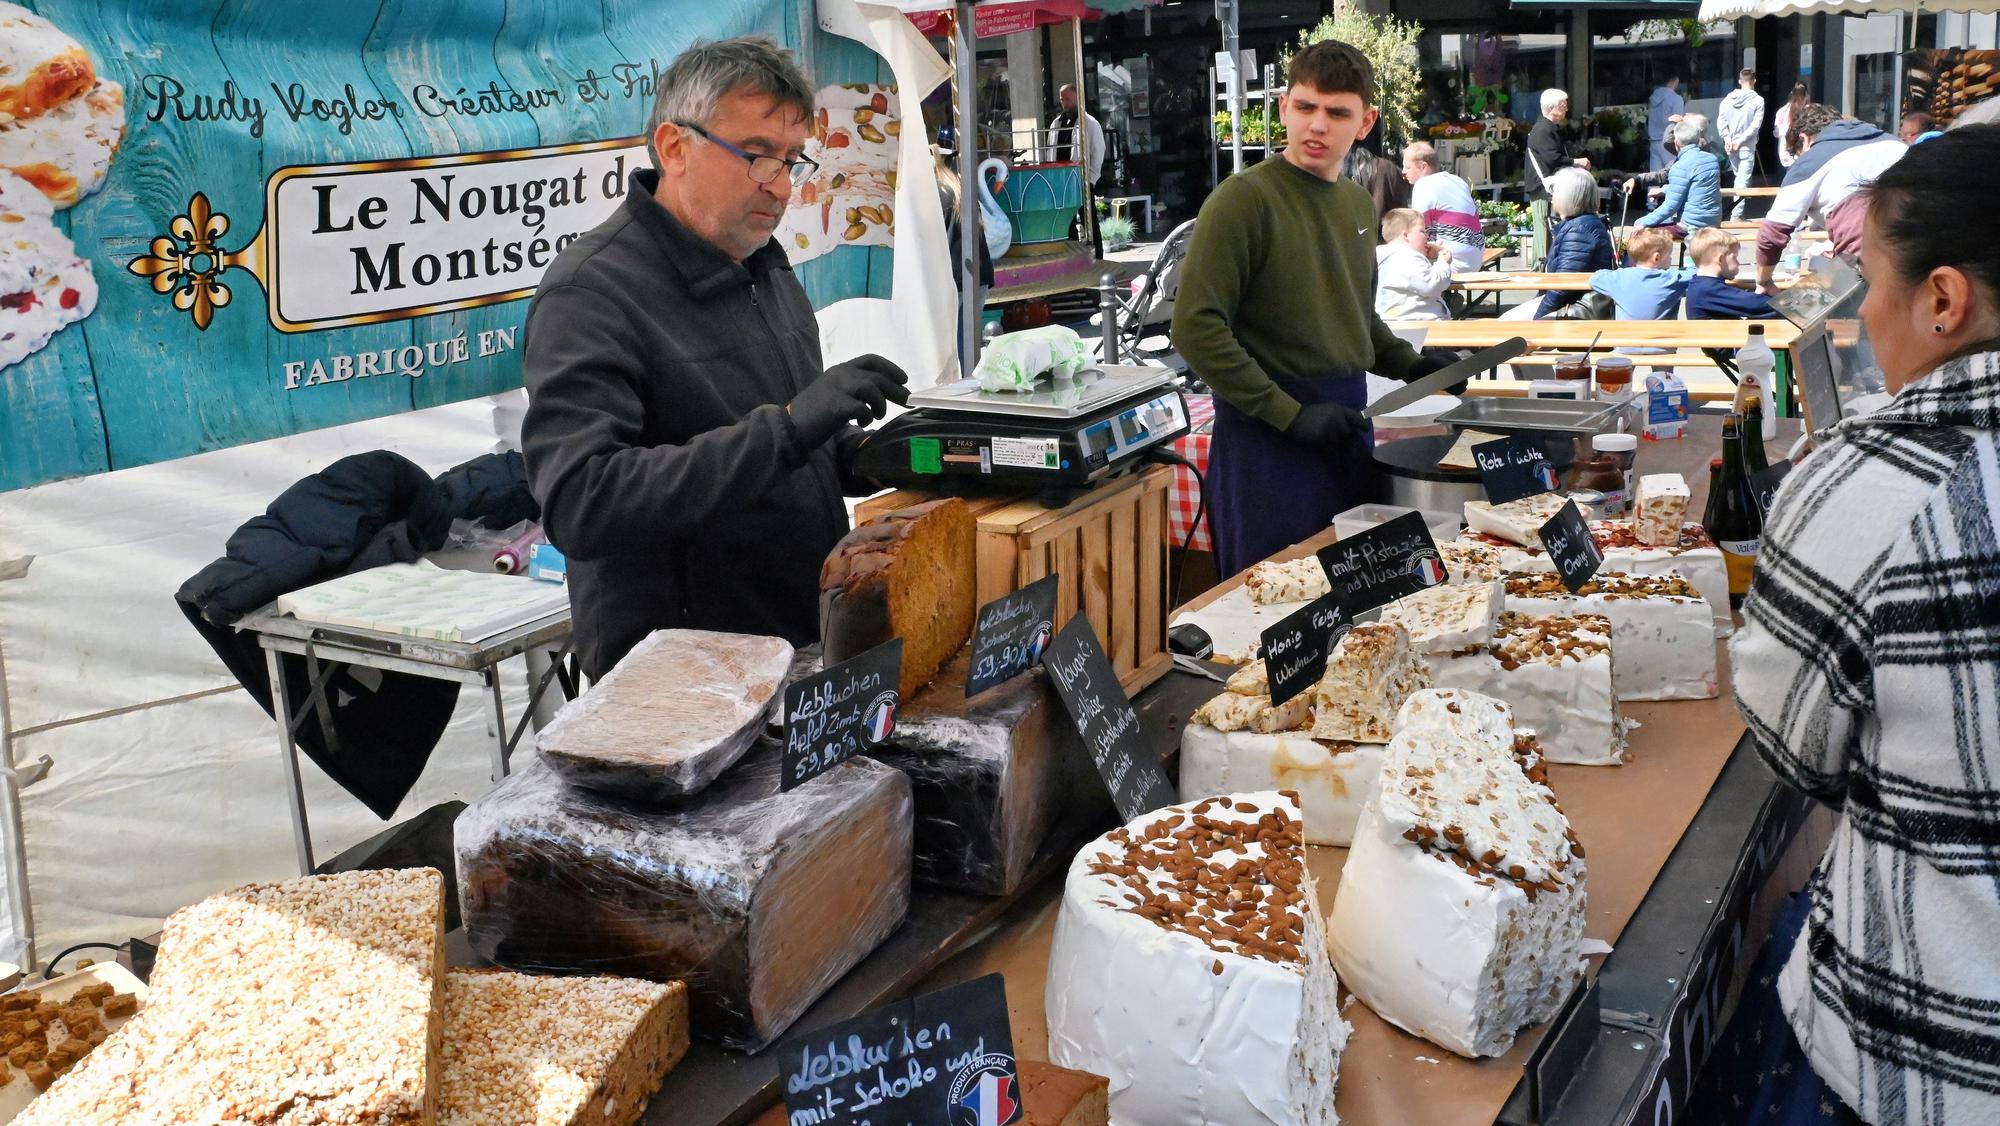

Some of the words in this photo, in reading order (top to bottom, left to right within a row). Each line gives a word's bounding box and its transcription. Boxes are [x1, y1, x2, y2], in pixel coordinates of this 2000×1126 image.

[143, 74, 267, 138] Rudy
[271, 82, 403, 136] Vogler
[413, 81, 566, 118] Créateur
[576, 69, 610, 103] et
[612, 58, 660, 99] Fa
[312, 184, 388, 235] Le
[410, 166, 587, 228] Nougat
[602, 155, 640, 200] d
[350, 223, 588, 295] Montség
[283, 326, 470, 390] FABRIQUÉ
[478, 325, 519, 359] EN
[1046, 442, 1054, 450] 14
[1478, 452, 1505, 472] Rote
[1332, 547, 1362, 577] mit
[1360, 534, 1427, 569] Pistazie
[1345, 578, 1362, 594] nd
[1268, 630, 1302, 660] Honig
[790, 672, 881, 723] Lebkuchen
[788, 711, 827, 755] Apfel
[826, 703, 861, 735] Zimt
[791, 1087, 845, 1126] mit
[850, 1057, 937, 1112] Schoko
[950, 1069, 971, 1105] PRODUIT
[969, 1056, 1008, 1071] FRANÇAIS
